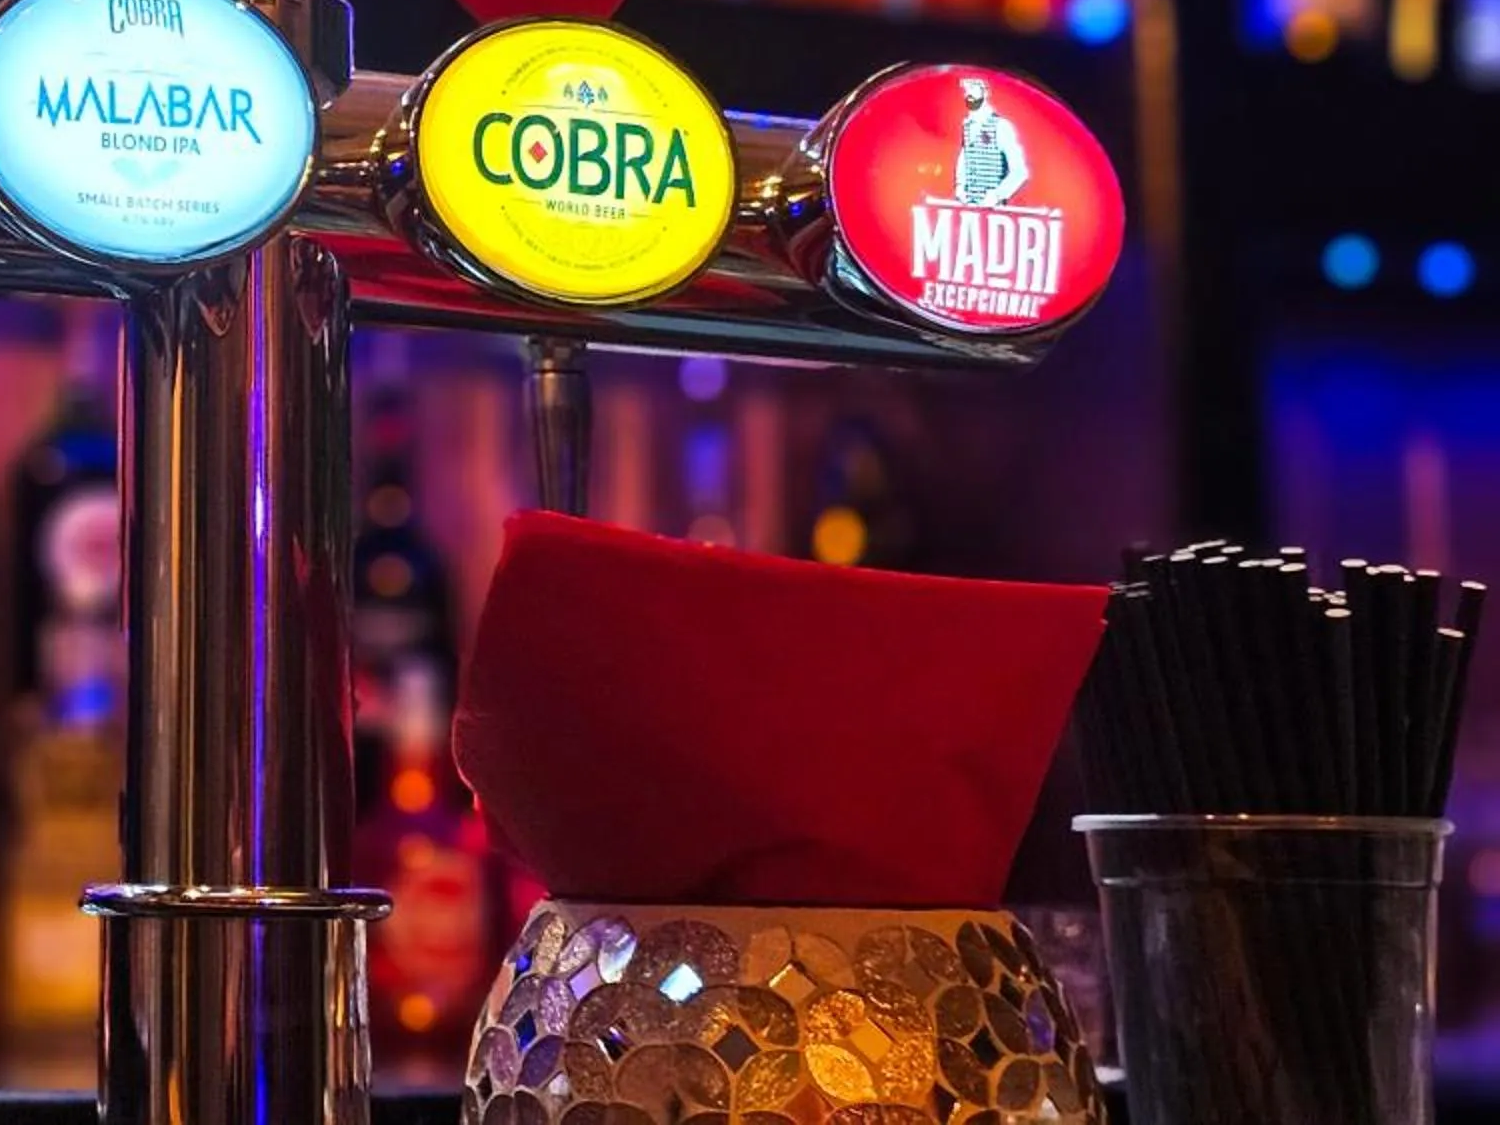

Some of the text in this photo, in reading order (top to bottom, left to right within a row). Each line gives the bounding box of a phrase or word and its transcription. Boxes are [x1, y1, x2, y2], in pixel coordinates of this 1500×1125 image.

[36, 75, 262, 145] MALABAR
[101, 132, 201, 156] BLOND IPA
[472, 112, 697, 208] COBRA
[77, 191, 220, 215] SMALL BATCH SERIES
[545, 199, 626, 220] WORLD BEER
[910, 205, 1064, 294] MADRÍ
[922, 282, 1042, 319] EXCEPCIONAL
